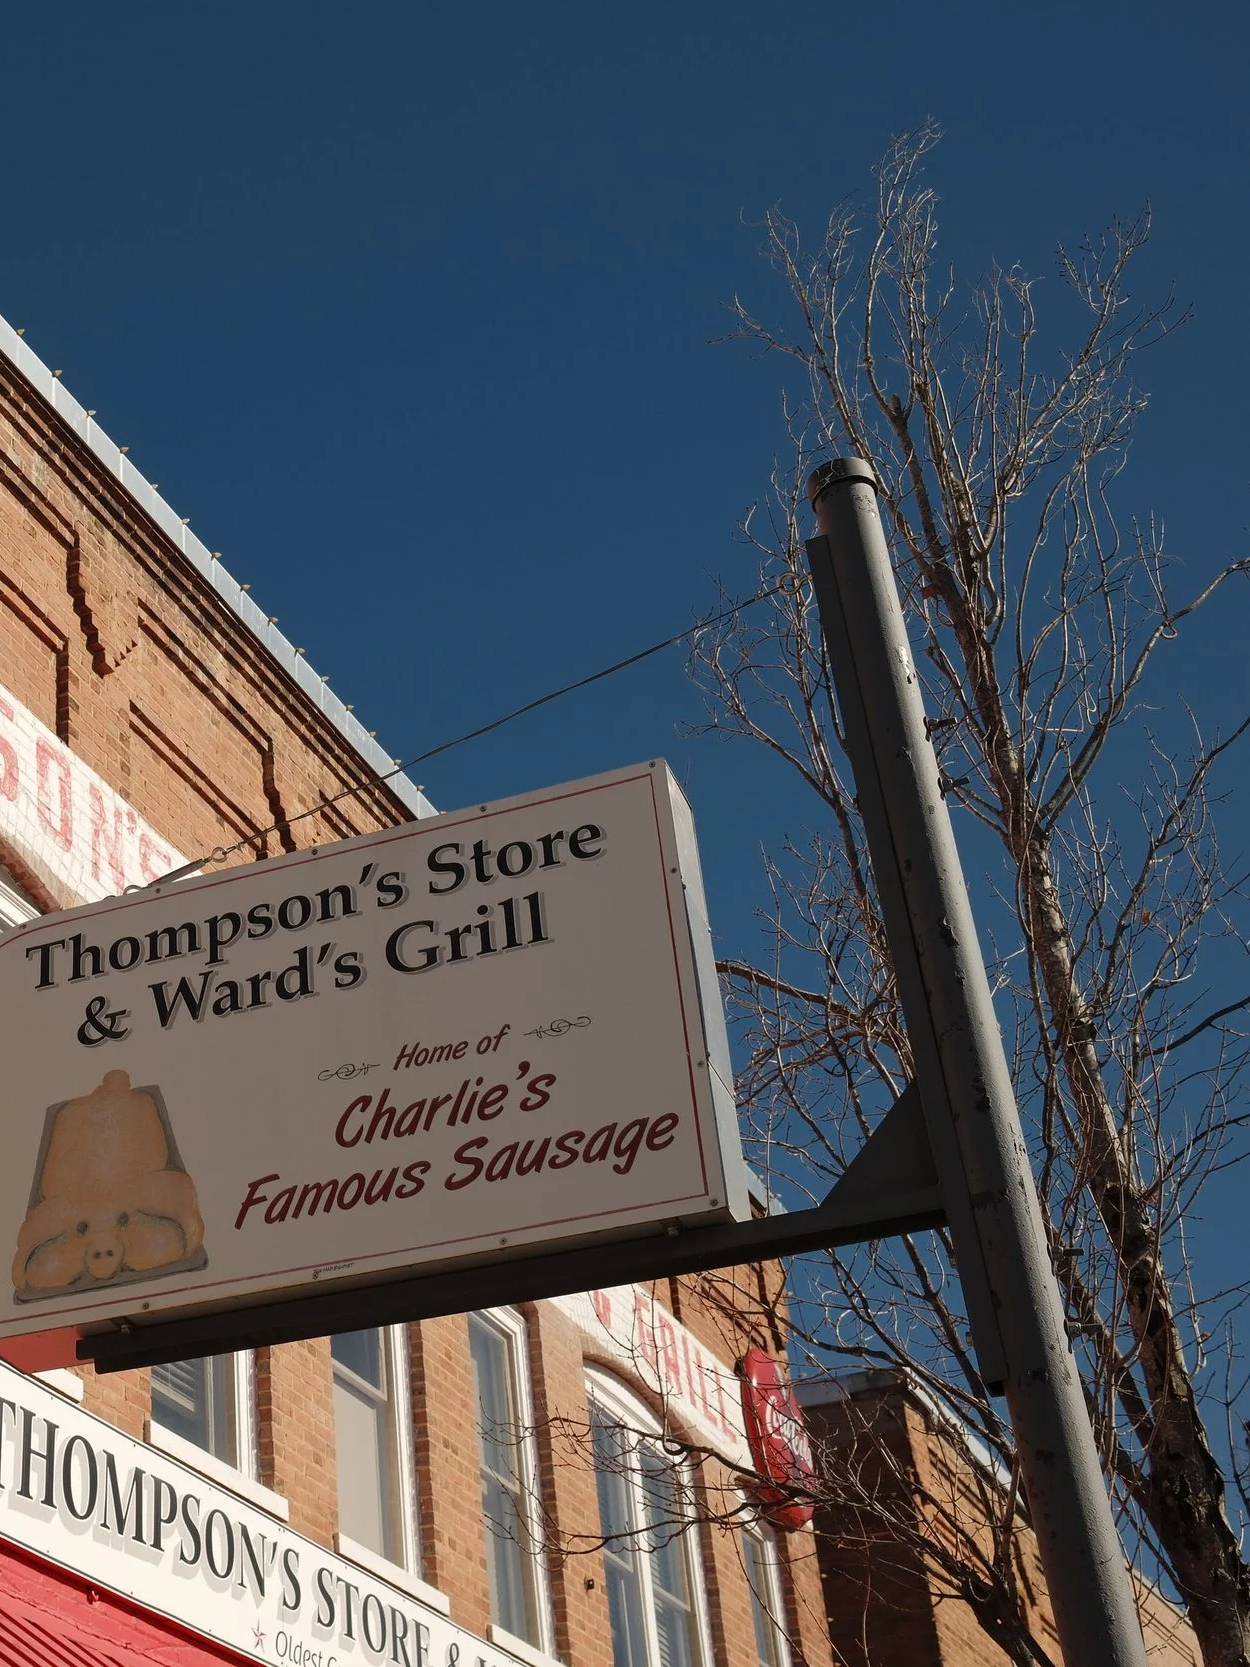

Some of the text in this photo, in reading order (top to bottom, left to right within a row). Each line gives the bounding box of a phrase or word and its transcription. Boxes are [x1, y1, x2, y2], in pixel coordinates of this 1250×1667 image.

[26, 823, 603, 990] Thompson's Store
[76, 891, 550, 1045] & Ward's Grill
[393, 1024, 511, 1071] Home of
[335, 1060, 556, 1148] Charlie's
[234, 1112, 679, 1231] Famous Sausage
[275, 1631, 323, 1667] Oldest
